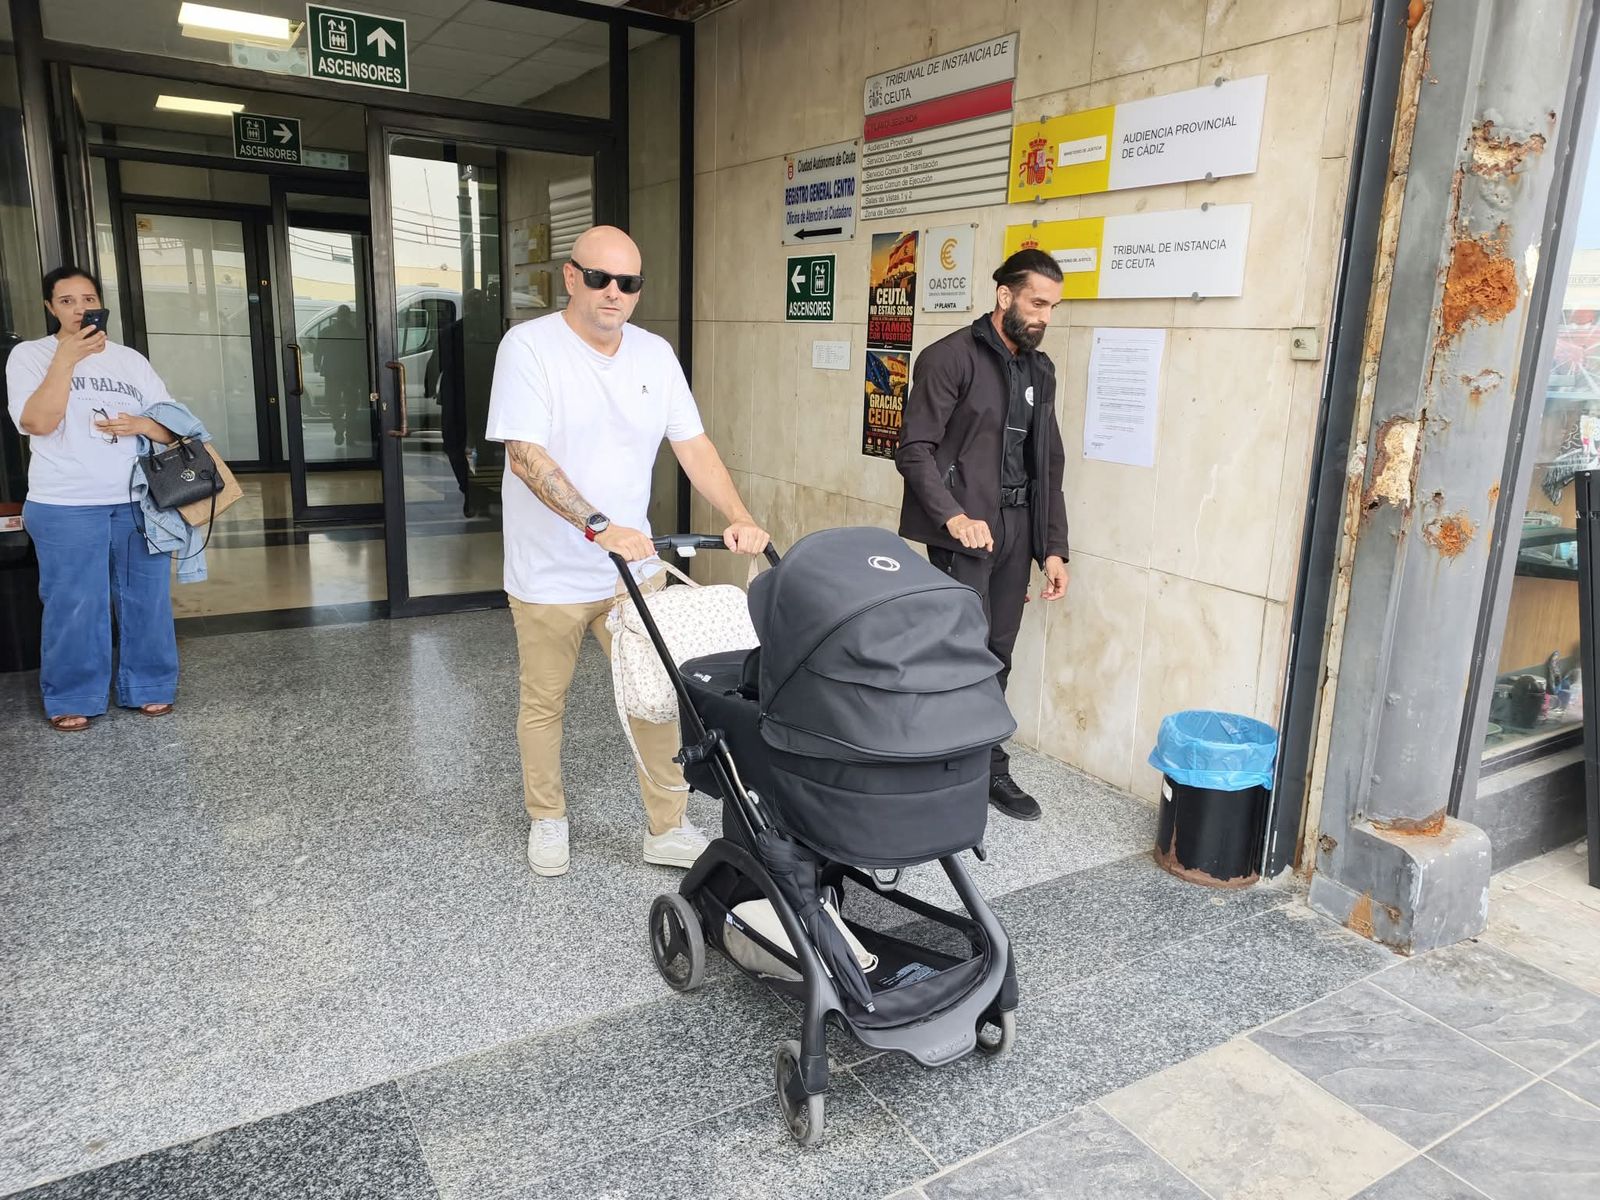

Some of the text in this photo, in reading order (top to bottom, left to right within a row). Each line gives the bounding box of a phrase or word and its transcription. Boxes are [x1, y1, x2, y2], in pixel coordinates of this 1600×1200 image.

[318, 56, 402, 84] ASCENSORES
[885, 40, 1009, 87] TRIBUNAL DE INSTANCIA DE
[884, 88, 912, 105] CEUTA
[1123, 115, 1238, 144] AUDIENCIA PROVINCIAL
[239, 144, 298, 161] ASCENSORES
[867, 137, 913, 152] Audiencia Provincial
[797, 151, 856, 173] Ciudad Autónoma de Ceuta
[866, 156, 884, 166] Servicio
[902, 149, 923, 159] General
[1121, 148, 1134, 159] DE
[866, 170, 884, 179] Servicio
[910, 160, 939, 170] Tramitación
[785, 177, 855, 206] REGISTRO GENERAL CENTRO
[865, 183, 884, 192] Servicio
[909, 175, 933, 187] Ejecución
[909, 191, 912, 199] 2
[786, 211, 800, 226] Oficina
[800, 210, 805, 224] de
[825, 206, 828, 220] al
[829, 204, 852, 220] Ciudadano
[864, 210, 876, 218] Zona
[1113, 239, 1227, 255] TRIBUNAL DE INSTANCIA
[1111, 257, 1155, 270] DE CEUTA
[929, 277, 966, 290] OASTCE
[876, 287, 909, 306] CEUTA,
[788, 301, 831, 316] ASCENSORES
[870, 305, 877, 315] NO
[897, 305, 913, 316] SOLOS
[869, 320, 912, 333] ESTAMOS
[869, 332, 912, 342] CON VOSOTROS
[869, 393, 903, 411] GRACIAS
[868, 407, 902, 428] CEUTA
